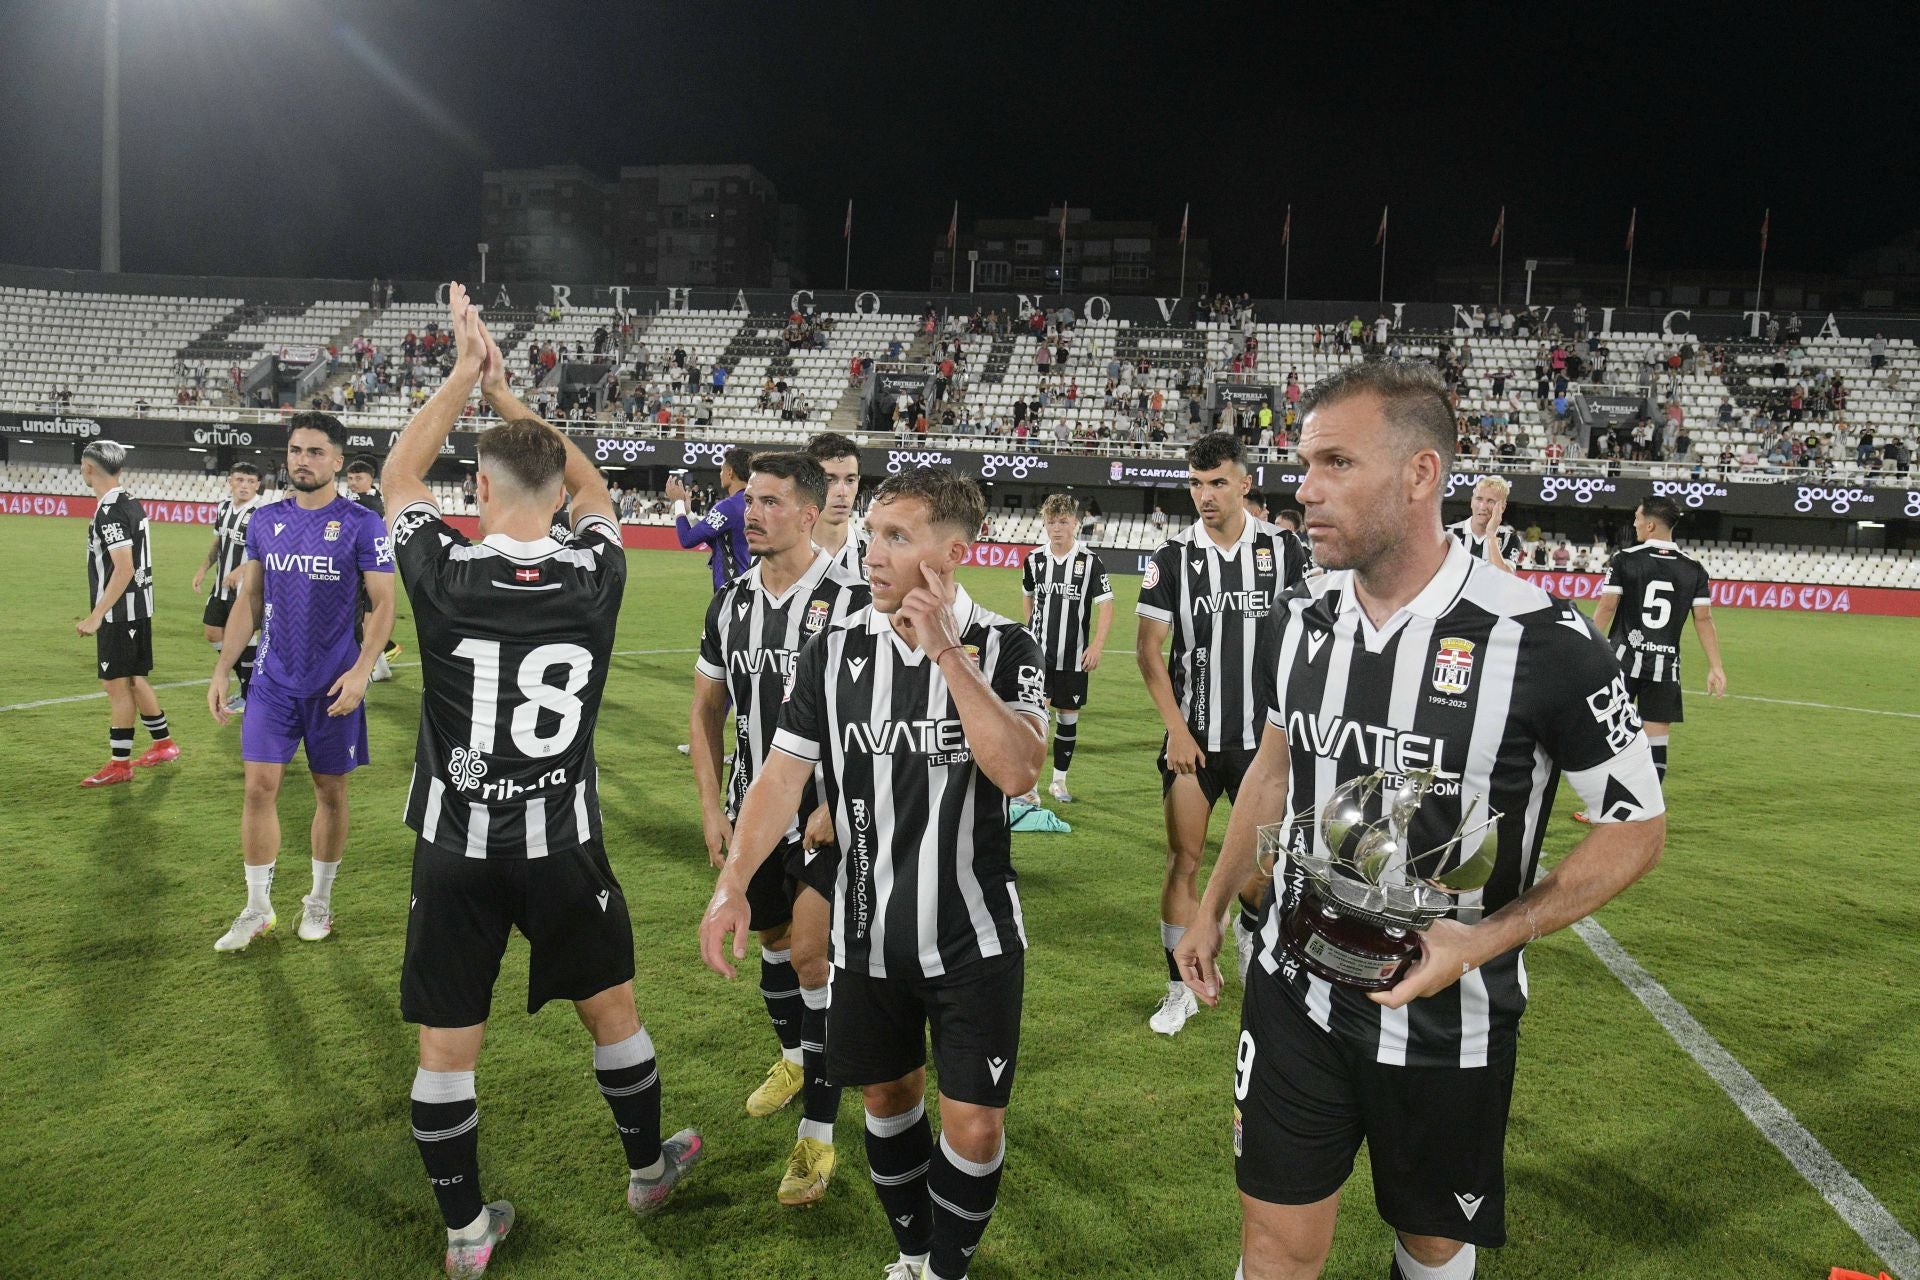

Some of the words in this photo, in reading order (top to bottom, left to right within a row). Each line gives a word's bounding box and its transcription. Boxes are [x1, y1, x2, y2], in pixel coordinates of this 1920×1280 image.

[981, 454, 1048, 479] gougo.es
[1125, 468, 1137, 477] FC
[1256, 466, 1265, 486] 1
[1540, 476, 1616, 503] gougo.es
[1794, 486, 1875, 514] gougo.es
[265, 553, 341, 575] AVATEL
[308, 573, 341, 582] TELECOM
[1036, 582, 1081, 597] AVATEL
[1244, 610, 1270, 619] TELECO
[1641, 580, 1674, 629] 5
[1641, 642, 1676, 654] ribera
[452, 638, 594, 758] 18
[1428, 695, 1468, 708] 1995-2025
[844, 719, 969, 754] AVATE
[1288, 710, 1461, 780] AVATEL
[929, 752, 970, 766] TELECO
[857, 833, 870, 939] INMOHOGARES
[1235, 1030, 1256, 1101] 9
